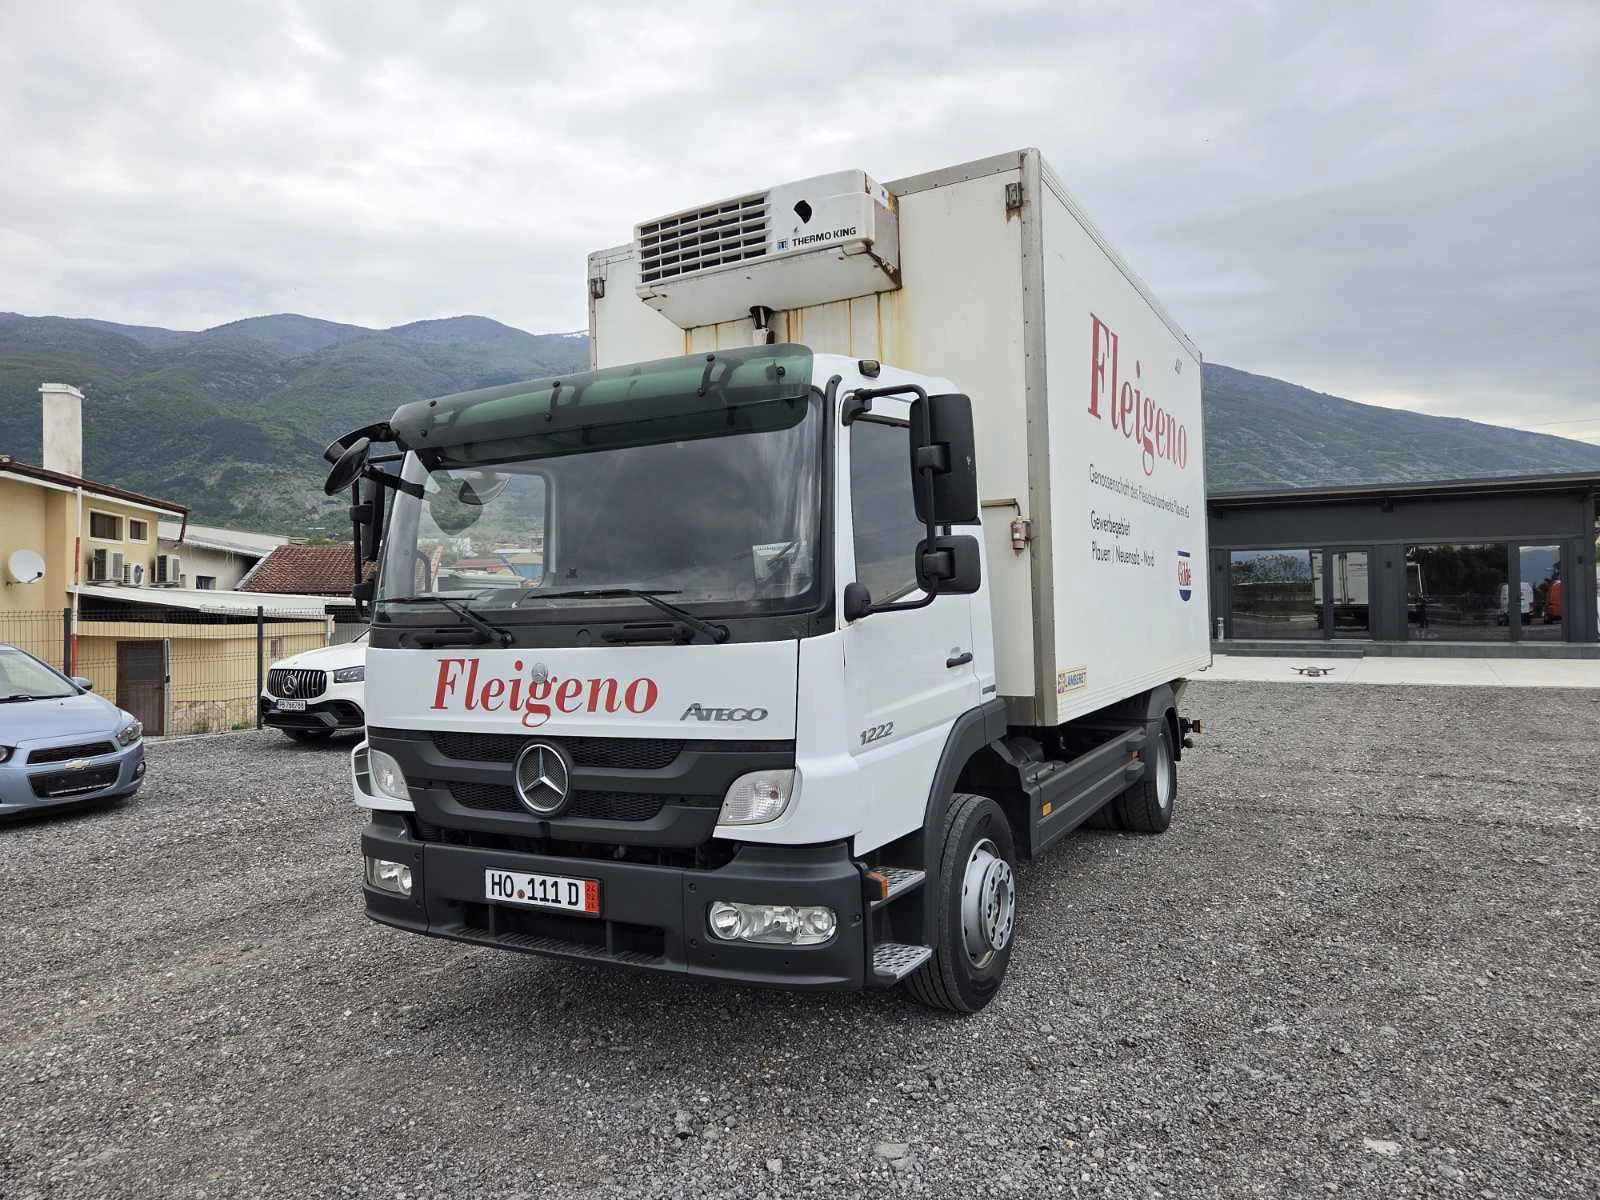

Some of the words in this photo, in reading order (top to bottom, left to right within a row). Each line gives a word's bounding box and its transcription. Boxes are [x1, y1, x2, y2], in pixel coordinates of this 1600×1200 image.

[792, 231, 831, 247] THERMO
[833, 226, 857, 239] KING
[1088, 311, 1187, 476] Fleigeno
[1091, 510, 1131, 540] Gewerbegebiet
[1092, 541, 1111, 562] Plauen
[1143, 551, 1155, 567] Nord
[430, 658, 658, 728] Fleigeno
[680, 702, 769, 722] ATEGO
[859, 721, 894, 746] 1222
[491, 872, 514, 898] HO
[527, 877, 562, 904] 111
[567, 882, 579, 906] D
